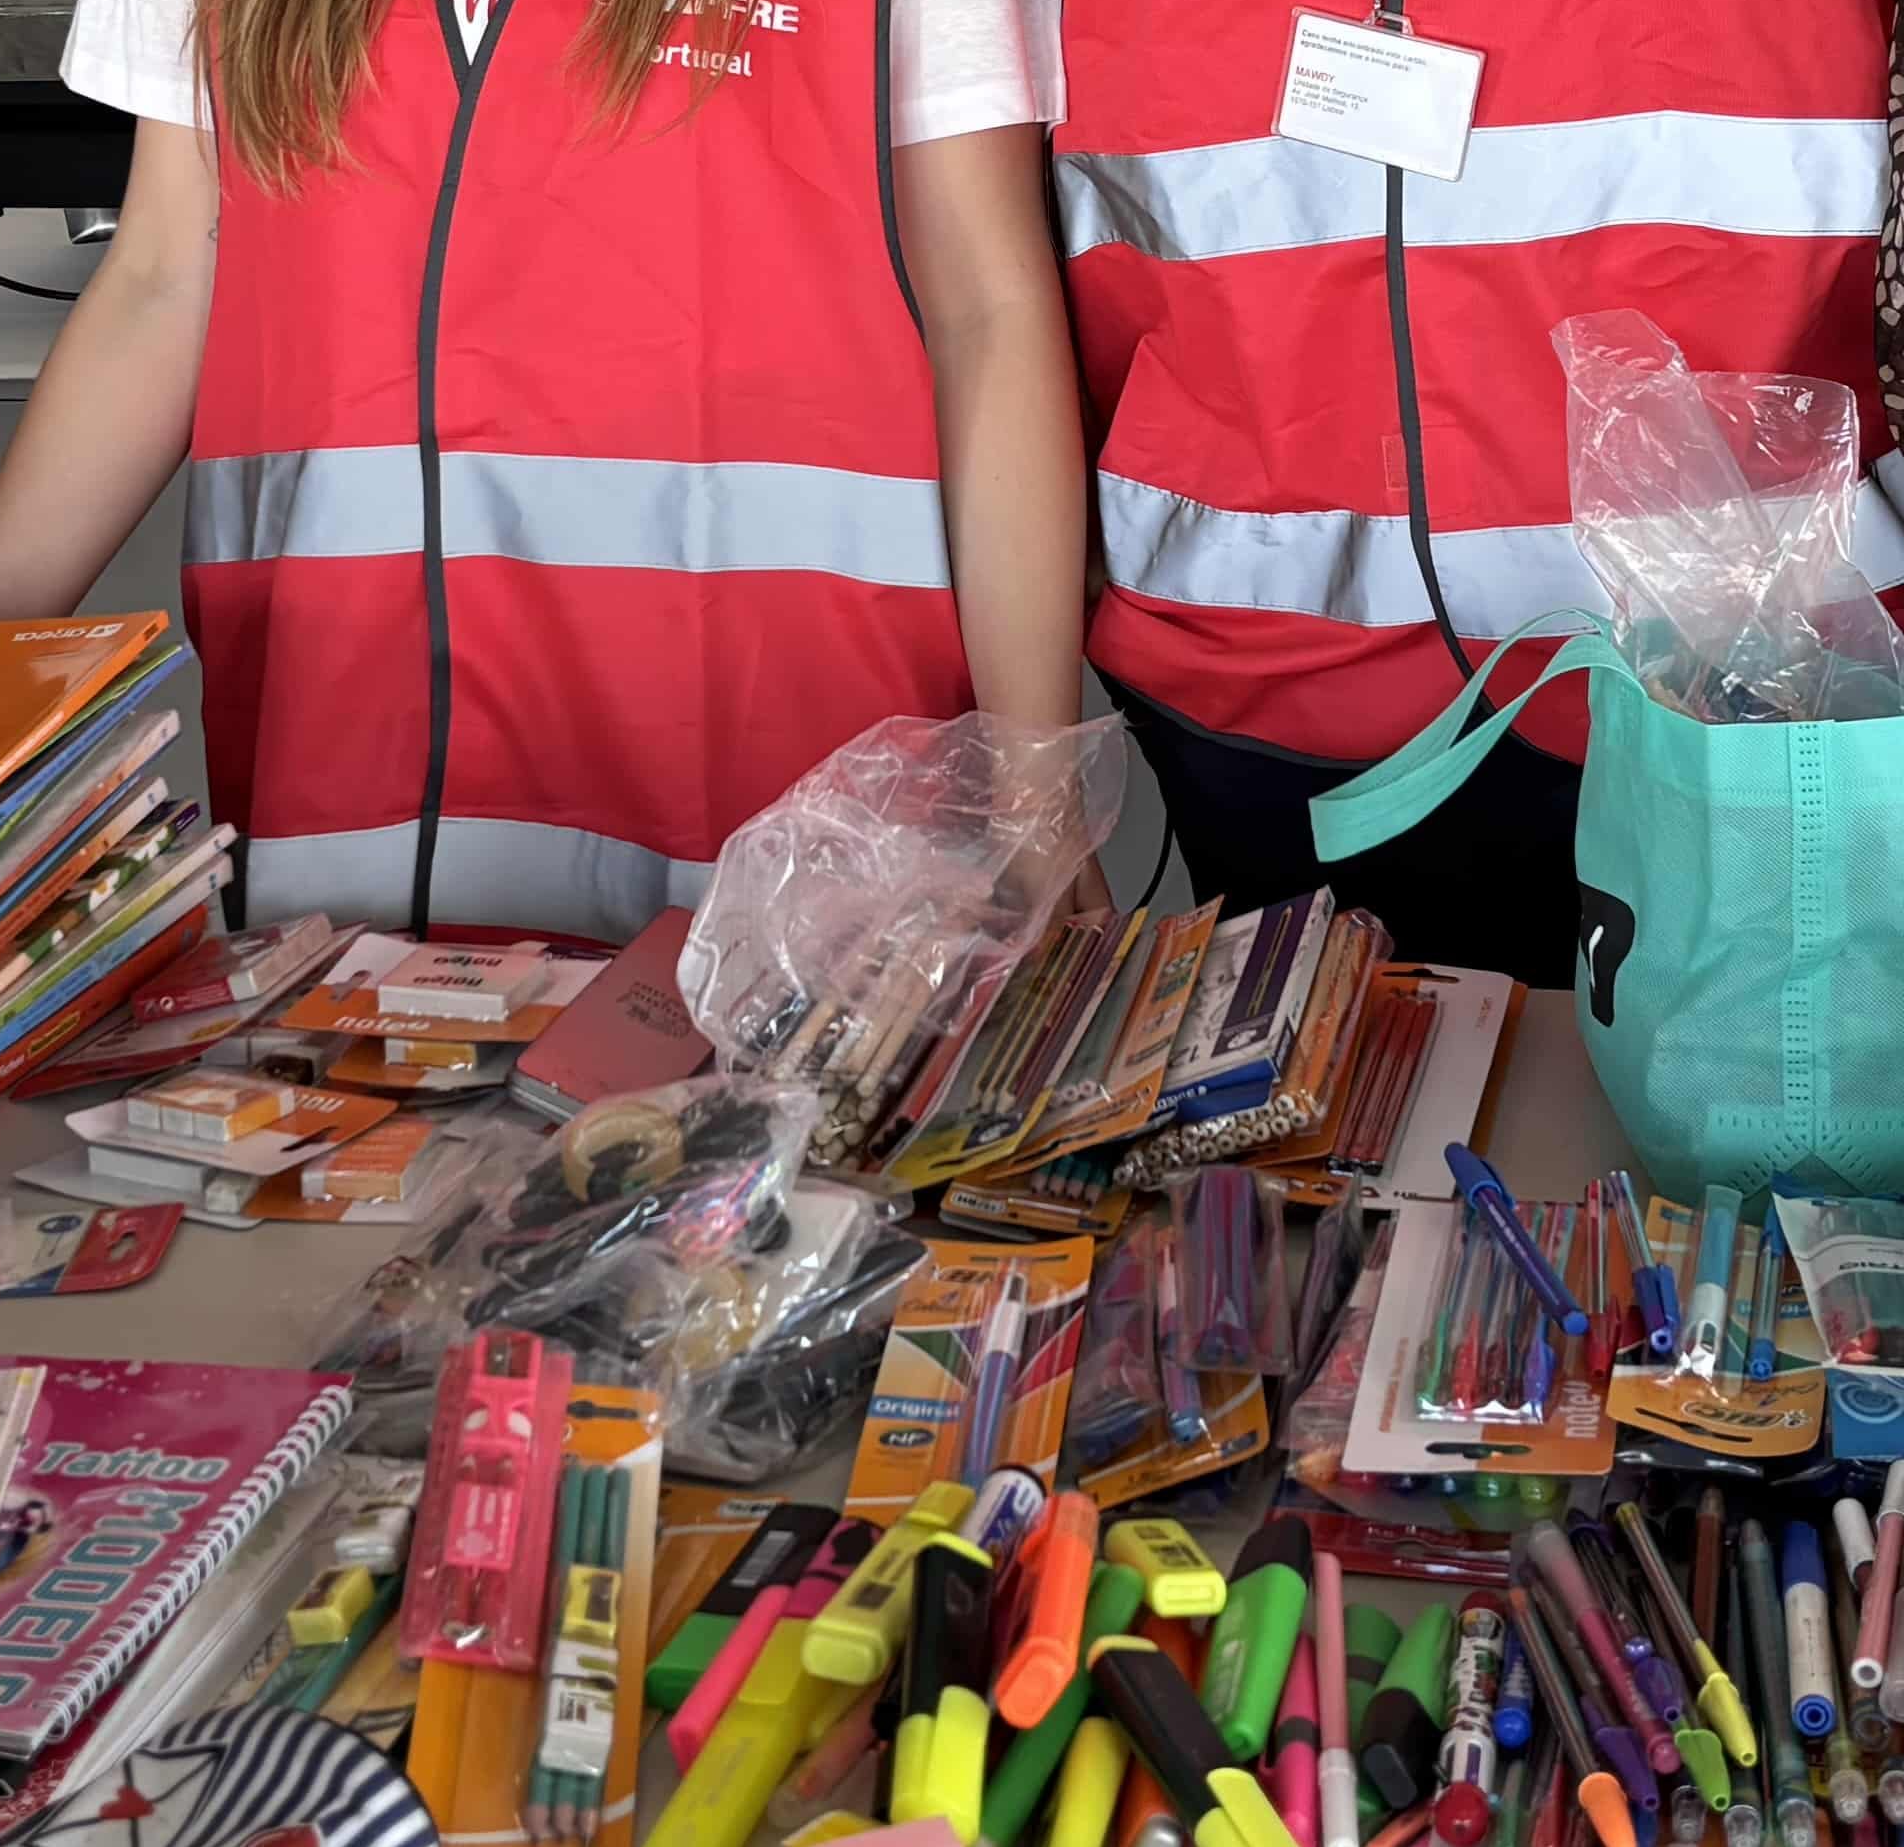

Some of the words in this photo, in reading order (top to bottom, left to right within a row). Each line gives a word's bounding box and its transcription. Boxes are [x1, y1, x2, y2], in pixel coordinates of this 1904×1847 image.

[1296, 66, 1336, 85] MAWDY
[873, 1399, 960, 1419] Original
[887, 1429, 927, 1445] NF
[35, 1441, 232, 1482] Tattoo
